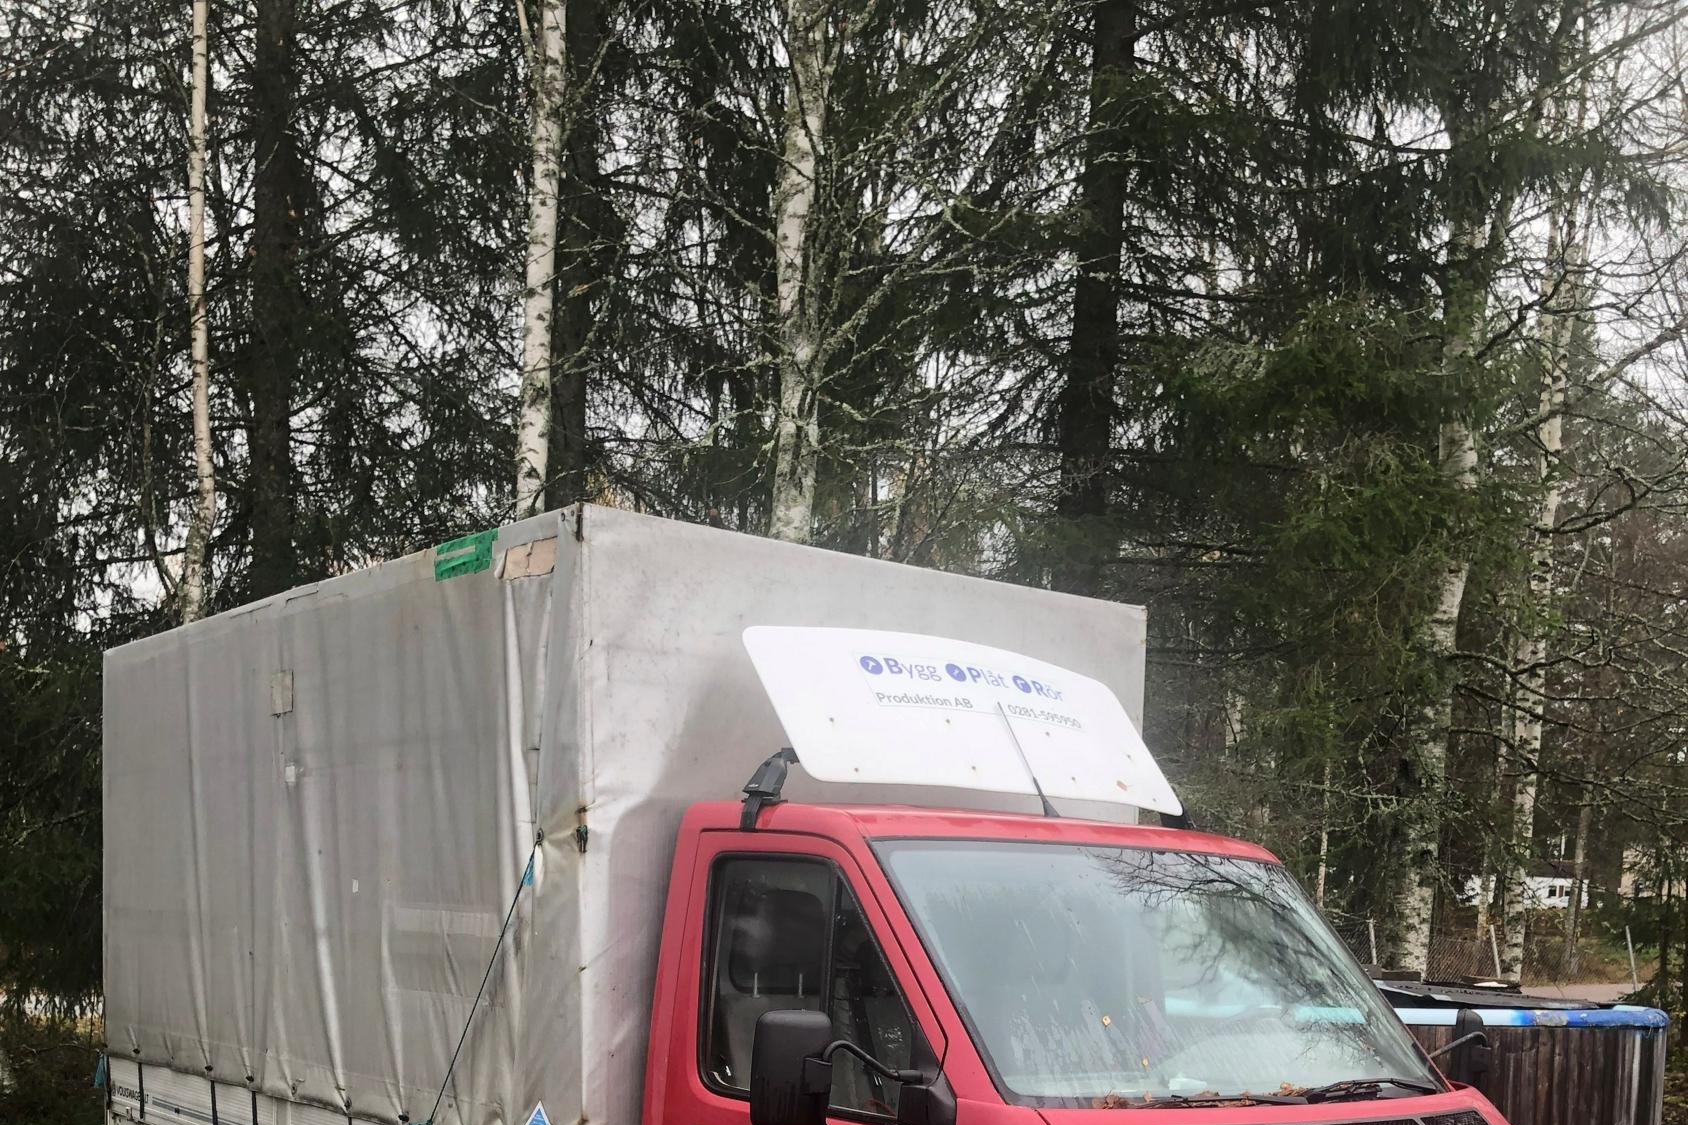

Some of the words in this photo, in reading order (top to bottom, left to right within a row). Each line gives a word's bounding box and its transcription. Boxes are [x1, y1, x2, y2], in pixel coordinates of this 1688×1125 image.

[883, 657, 942, 682] Bygg
[966, 667, 1009, 689] Plåt
[1031, 679, 1063, 701] Rör
[875, 692, 953, 707] Produktion
[954, 696, 974, 709] AB
